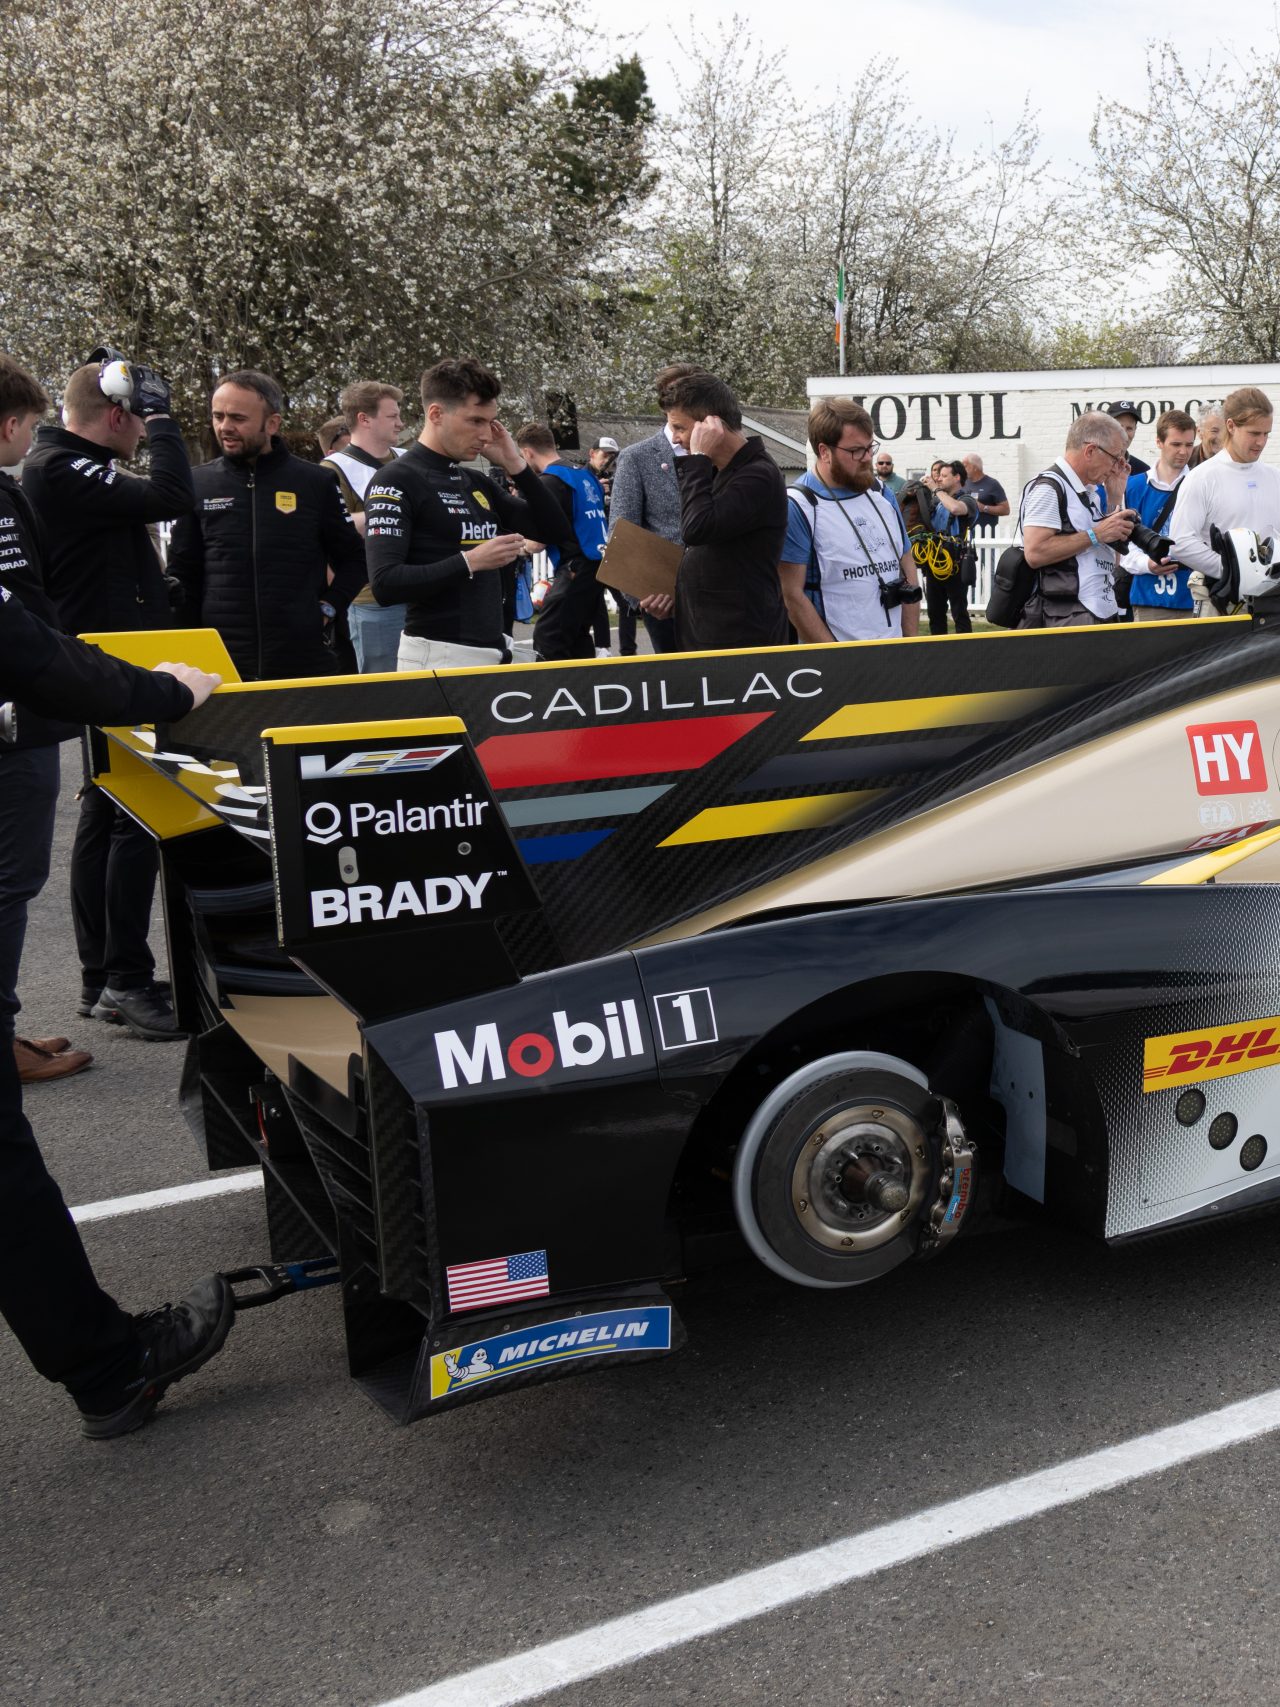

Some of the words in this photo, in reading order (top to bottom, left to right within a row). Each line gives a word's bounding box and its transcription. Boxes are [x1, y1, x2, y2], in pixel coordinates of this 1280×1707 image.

[853, 392, 1022, 441] OTUL
[369, 485, 404, 496] Hertz
[369, 502, 402, 512] JOTA
[584, 510, 596, 519] TV
[0, 517, 15, 525] rtz
[368, 517, 400, 526] BRADY
[461, 521, 498, 540] Hertz
[368, 527, 391, 536] Mobil
[0, 559, 28, 571] BRAD
[490, 668, 824, 723] CADILLAC
[1193, 732, 1254, 783] HY
[350, 793, 489, 837] Palantir
[1199, 806, 1234, 824] FIA
[310, 872, 493, 928] BRADY
[434, 999, 644, 1089] Mobil
[1166, 1027, 1279, 1076] DHL
[498, 1320, 650, 1364] MICHELIN
